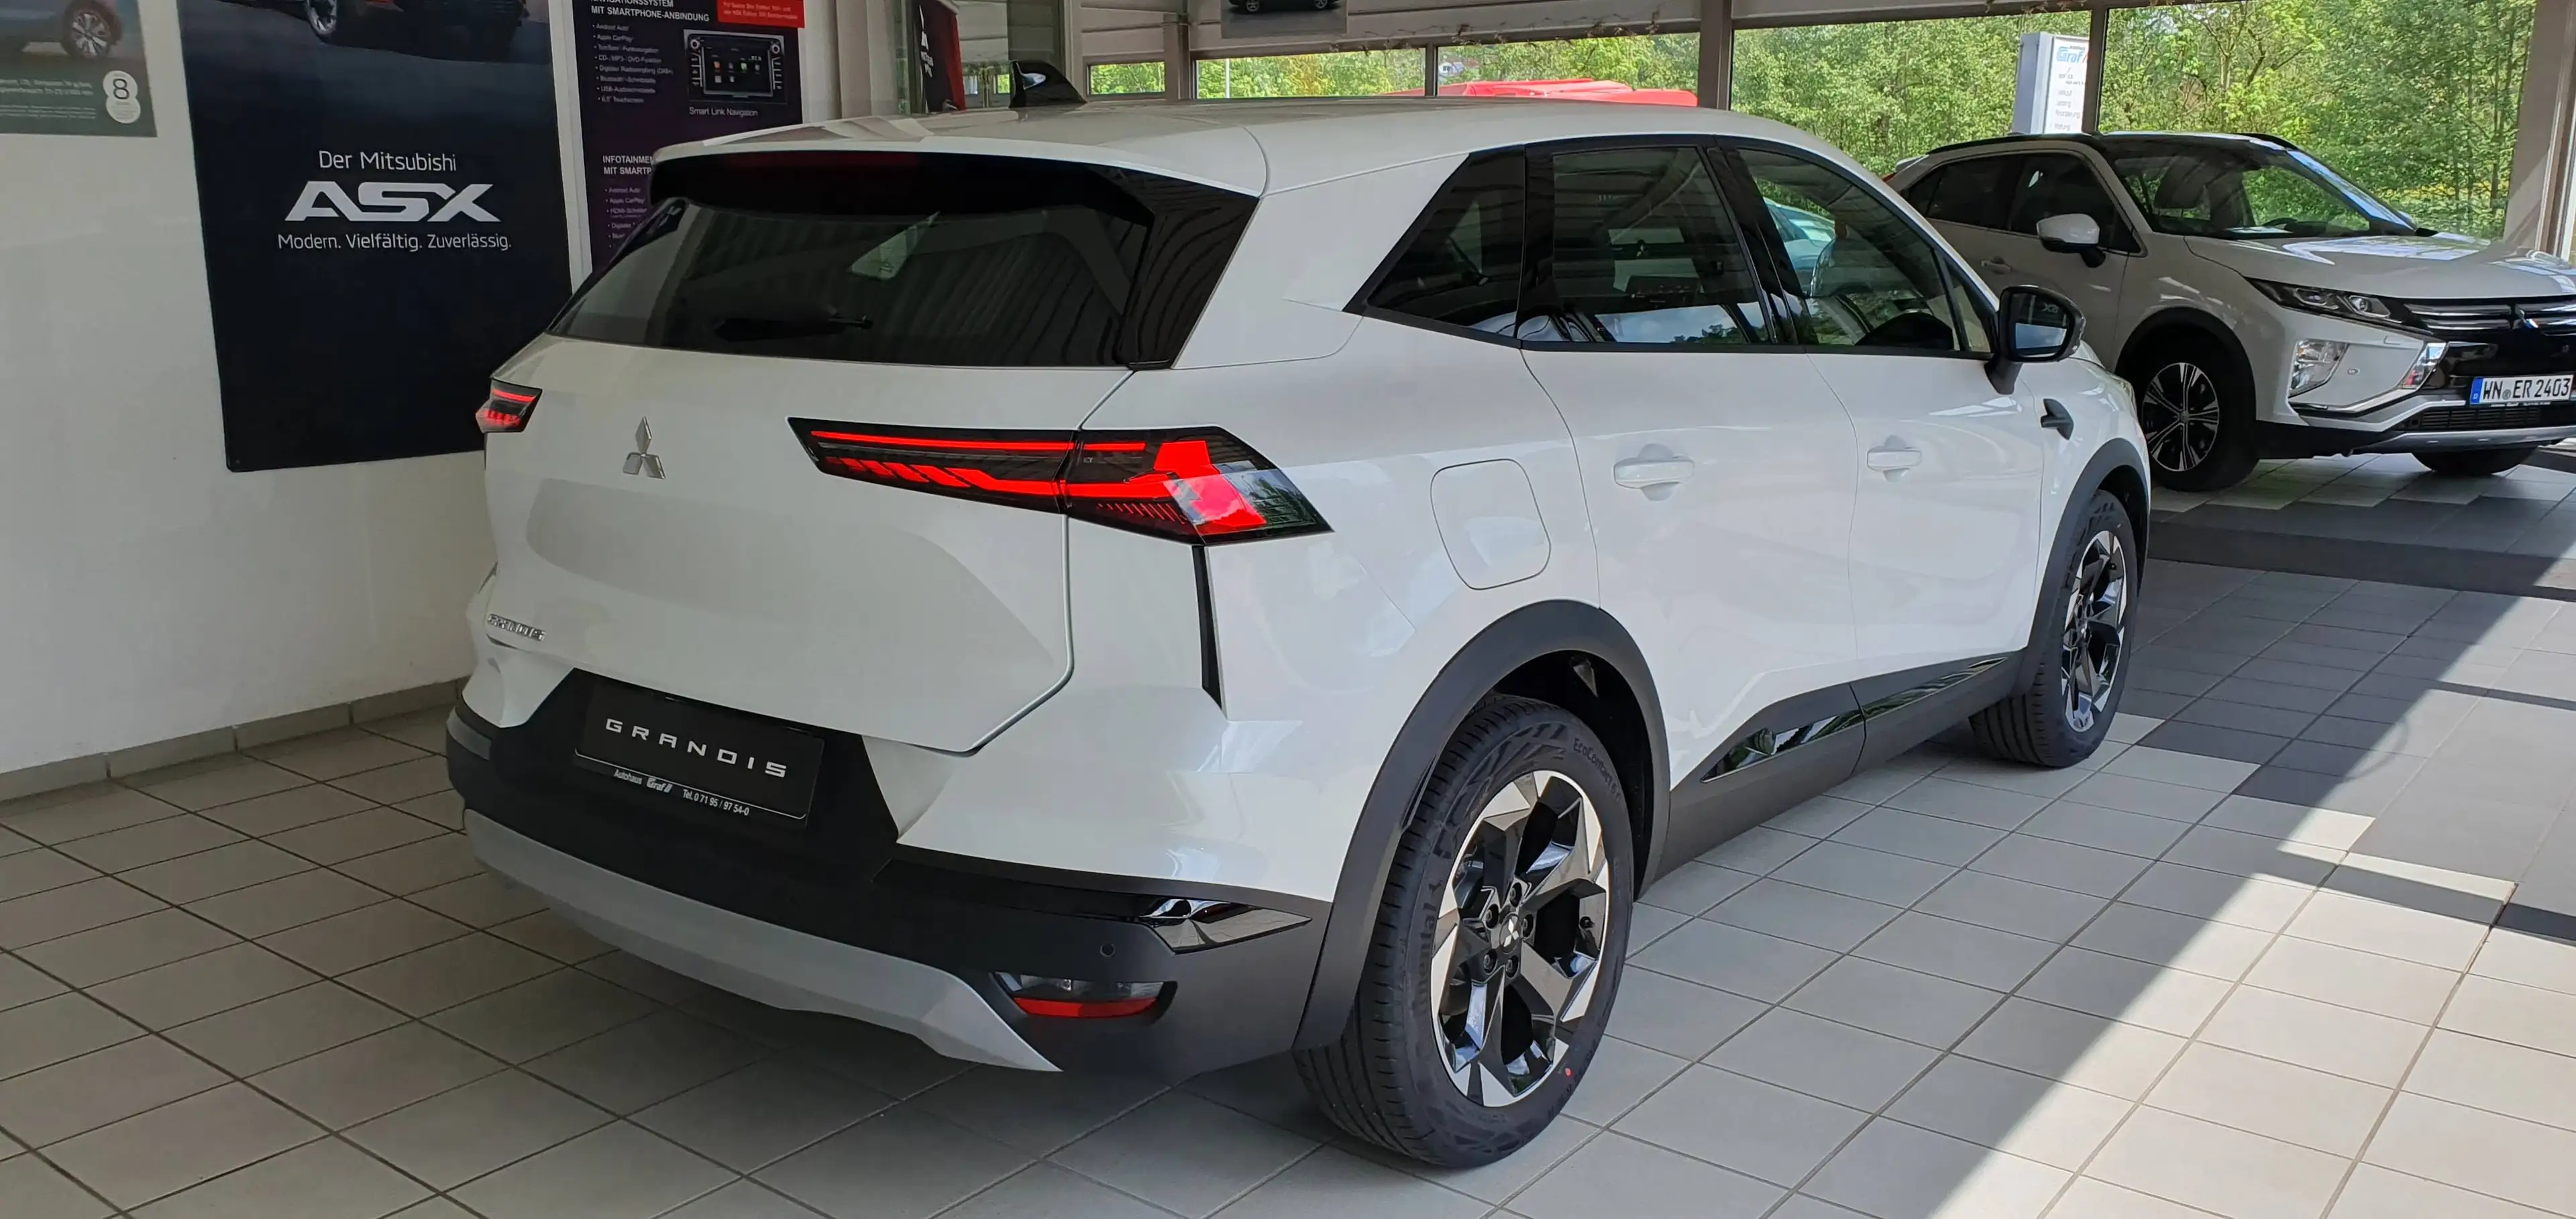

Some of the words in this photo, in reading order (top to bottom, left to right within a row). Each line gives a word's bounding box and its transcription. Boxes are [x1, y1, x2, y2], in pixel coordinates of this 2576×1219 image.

[591, 5, 604, 14] MIT
[607, 7, 709, 21] SMARTPHONE-ANBINDUNG
[2057, 46, 2086, 64] Graf
[113, 78, 129, 99] 8
[690, 107, 709, 115] Smart
[711, 107, 724, 115] Link
[319, 150, 352, 168] Der
[360, 152, 457, 171] Mitsubishi
[604, 166, 617, 174] MIT
[285, 180, 501, 222] ASX
[278, 233, 341, 249] Modern.
[345, 233, 422, 252] Vielfältig.
[428, 233, 511, 251] Zuverlässig.
[2483, 380, 2503, 399] WN
[2513, 380, 2532, 399] ER
[2534, 378, 2571, 398] 2403
[606, 719, 786, 778] GRANDIS
[614, 769, 642, 784] Autohaus
[647, 778, 667, 792] Graf
[700, 794, 708, 804] 71
[723, 801, 733, 810] 97
[733, 804, 750, 816] 54-0
